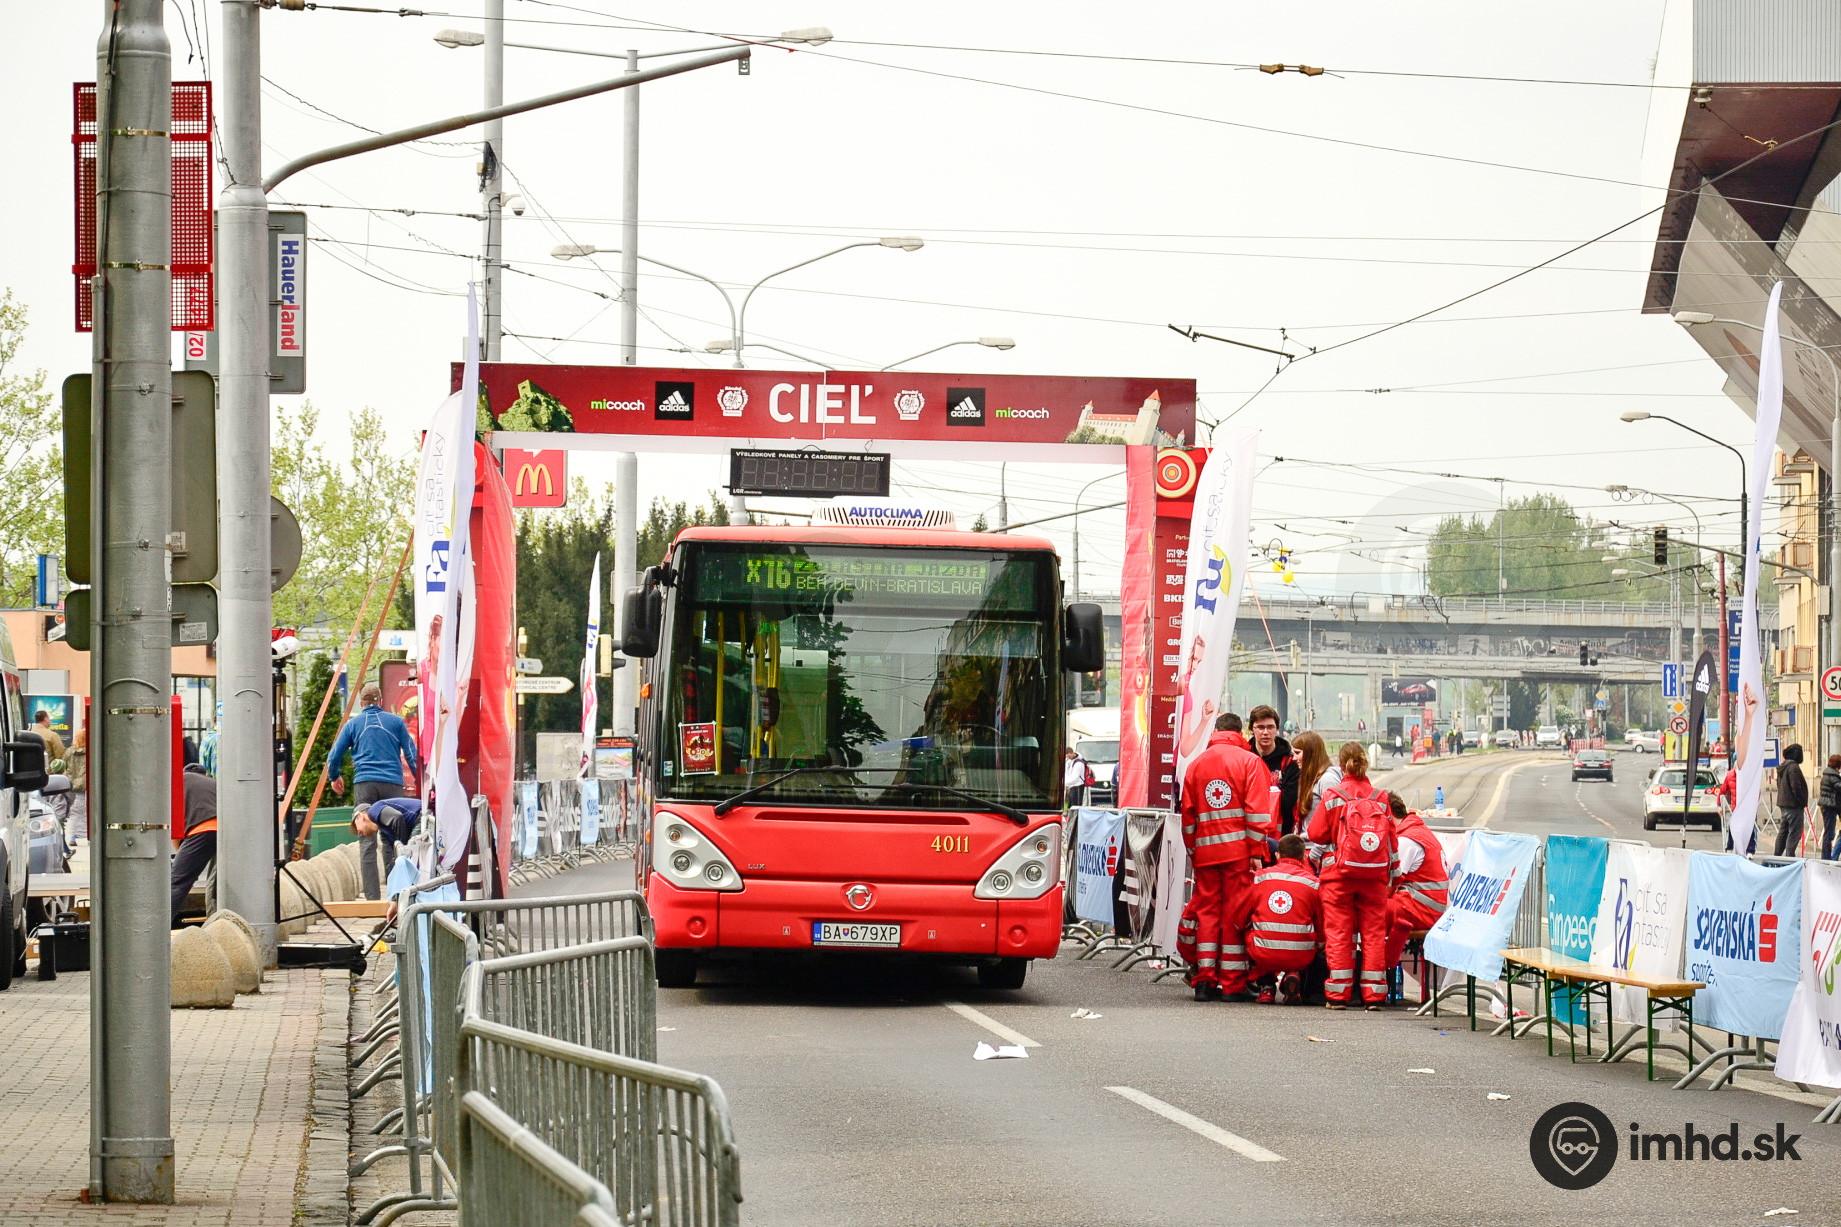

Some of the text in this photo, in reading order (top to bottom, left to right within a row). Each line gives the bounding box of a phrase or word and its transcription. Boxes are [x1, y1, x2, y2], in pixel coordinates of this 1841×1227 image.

[281, 240, 300, 350] Hauerland
[590, 399, 645, 411] micoach
[658, 402, 690, 412] adidas
[768, 382, 877, 425] CIEĽ
[950, 408, 982, 418] adidas
[995, 407, 1050, 419] micoach
[849, 507, 923, 519] AUTOCLIMA
[931, 835, 969, 853] 4011
[823, 924, 898, 942] BA 679XP
